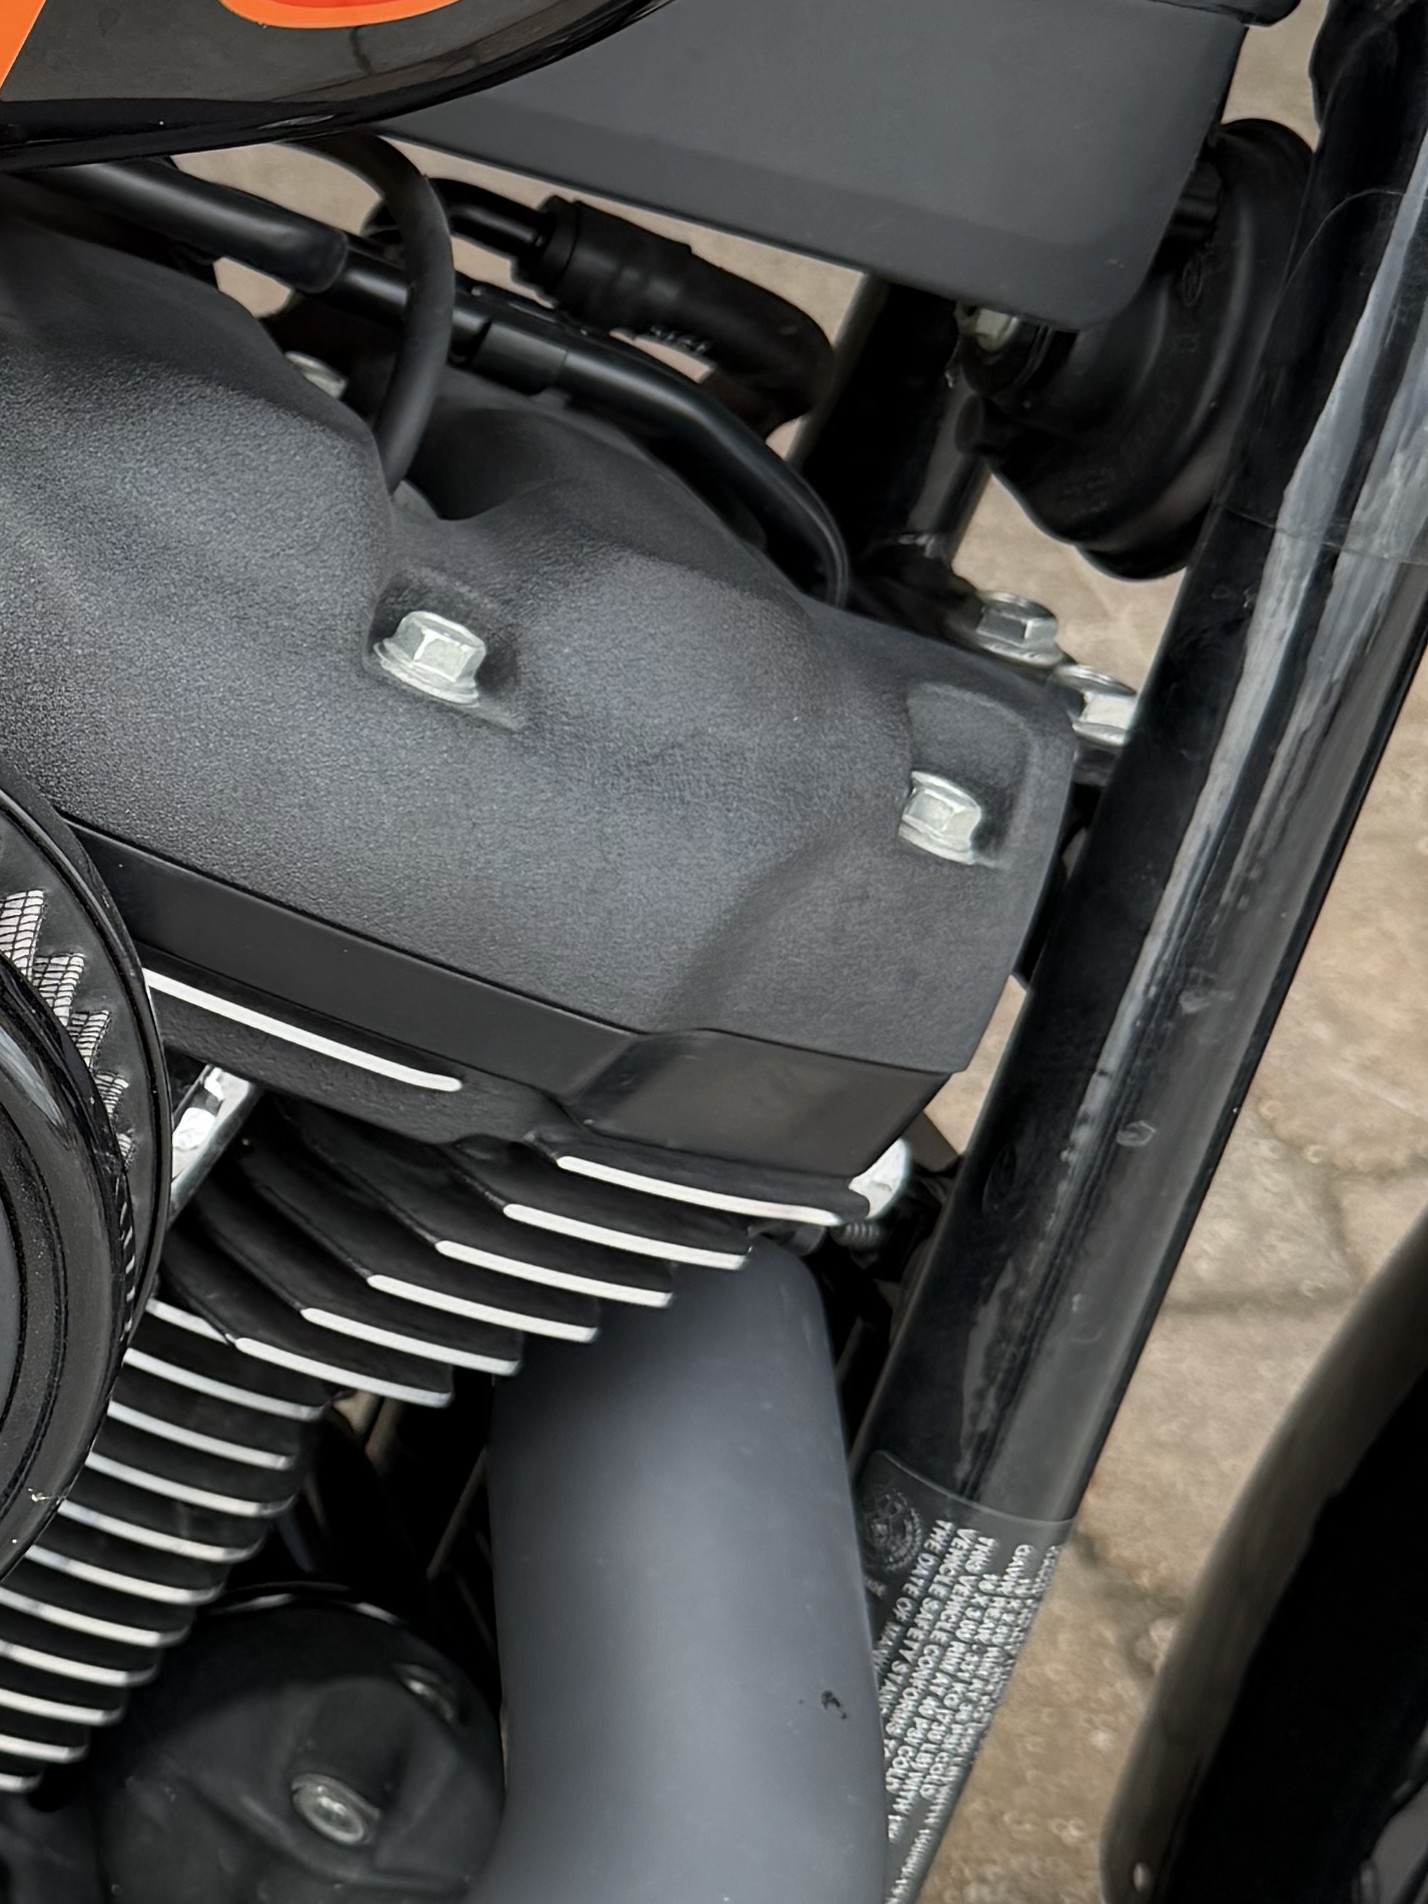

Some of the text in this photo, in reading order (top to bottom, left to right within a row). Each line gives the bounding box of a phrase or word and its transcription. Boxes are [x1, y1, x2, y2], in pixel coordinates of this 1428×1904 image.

[922, 1519, 953, 1556] THE
[963, 1536, 994, 1575] THIS
[900, 1552, 937, 1600] DATE
[926, 1527, 975, 1601] VEHICLE
[896, 1596, 941, 1664] SAFETY
[928, 1573, 976, 1646] VEHICLE
[883, 1643, 943, 1737] CONFORMS
[891, 1771, 924, 1814] WITH
[918, 1751, 951, 1800] COLD
